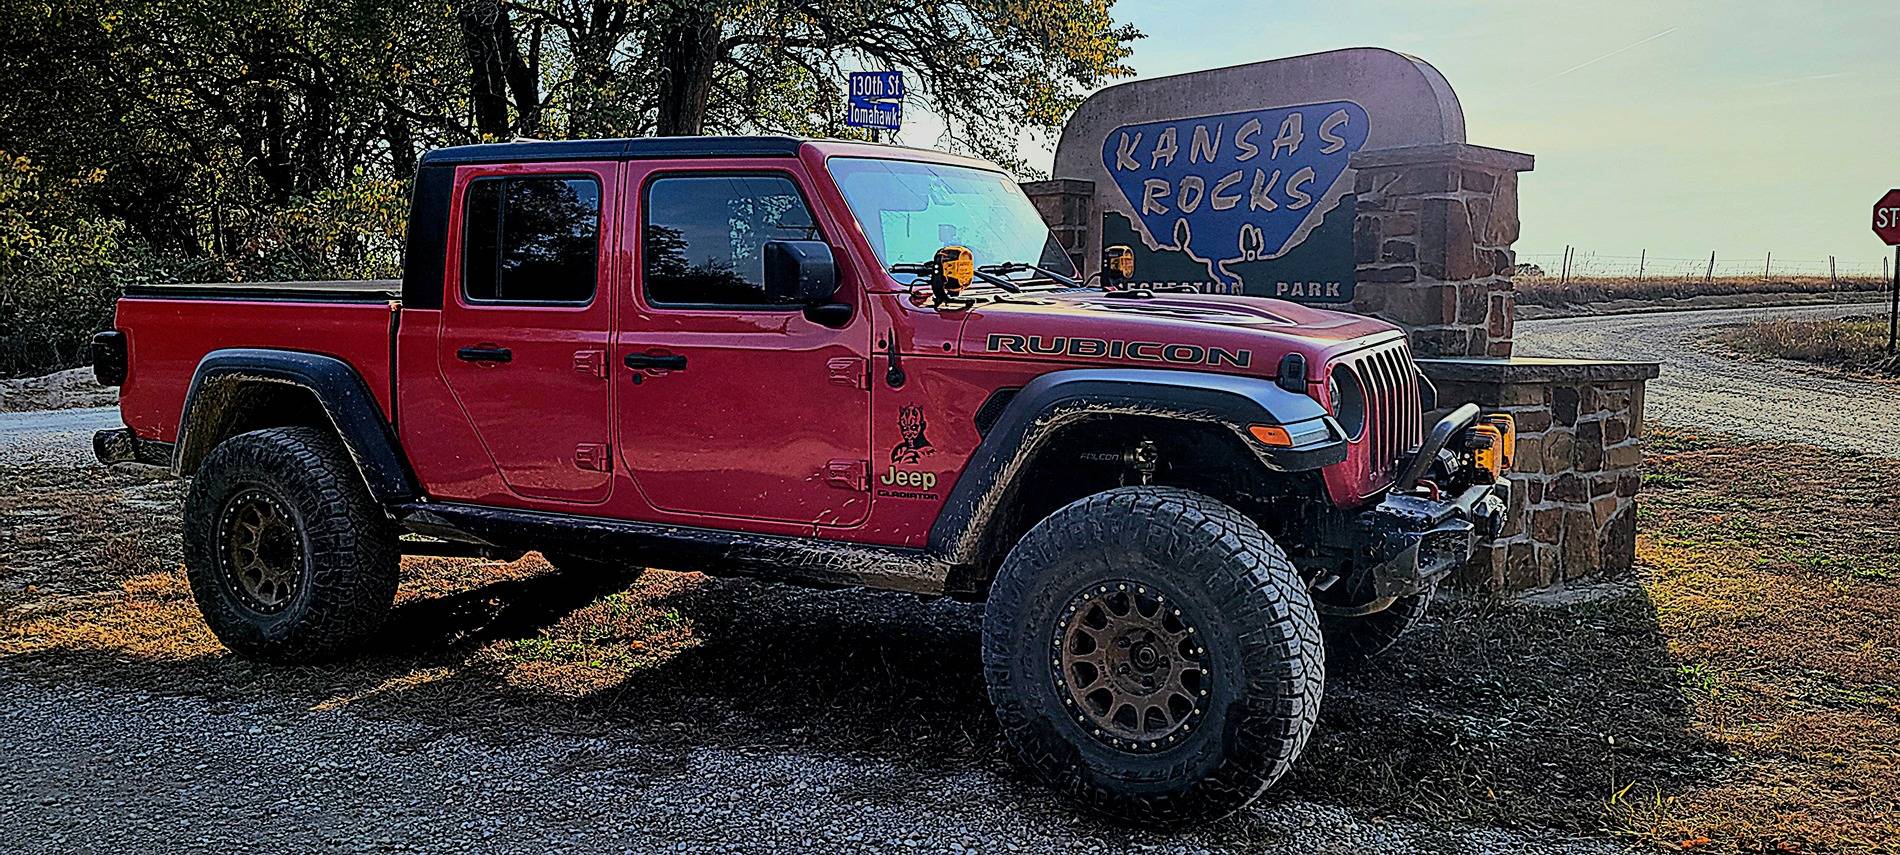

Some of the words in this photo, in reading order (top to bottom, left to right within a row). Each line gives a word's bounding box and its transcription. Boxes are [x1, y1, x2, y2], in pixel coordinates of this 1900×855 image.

[853, 75, 883, 96] 130th
[888, 75, 900, 96] St
[850, 102, 898, 126] Tomahawk
[1116, 109, 1350, 171] KANSAS
[1142, 166, 1315, 216] ROCKS
[1276, 282, 1341, 297] PARK
[986, 333, 1252, 369] RUBICON
[1080, 453, 1119, 461] FALCON
[880, 465, 937, 491] Jeep
[877, 489, 939, 500] GLADIATOR
